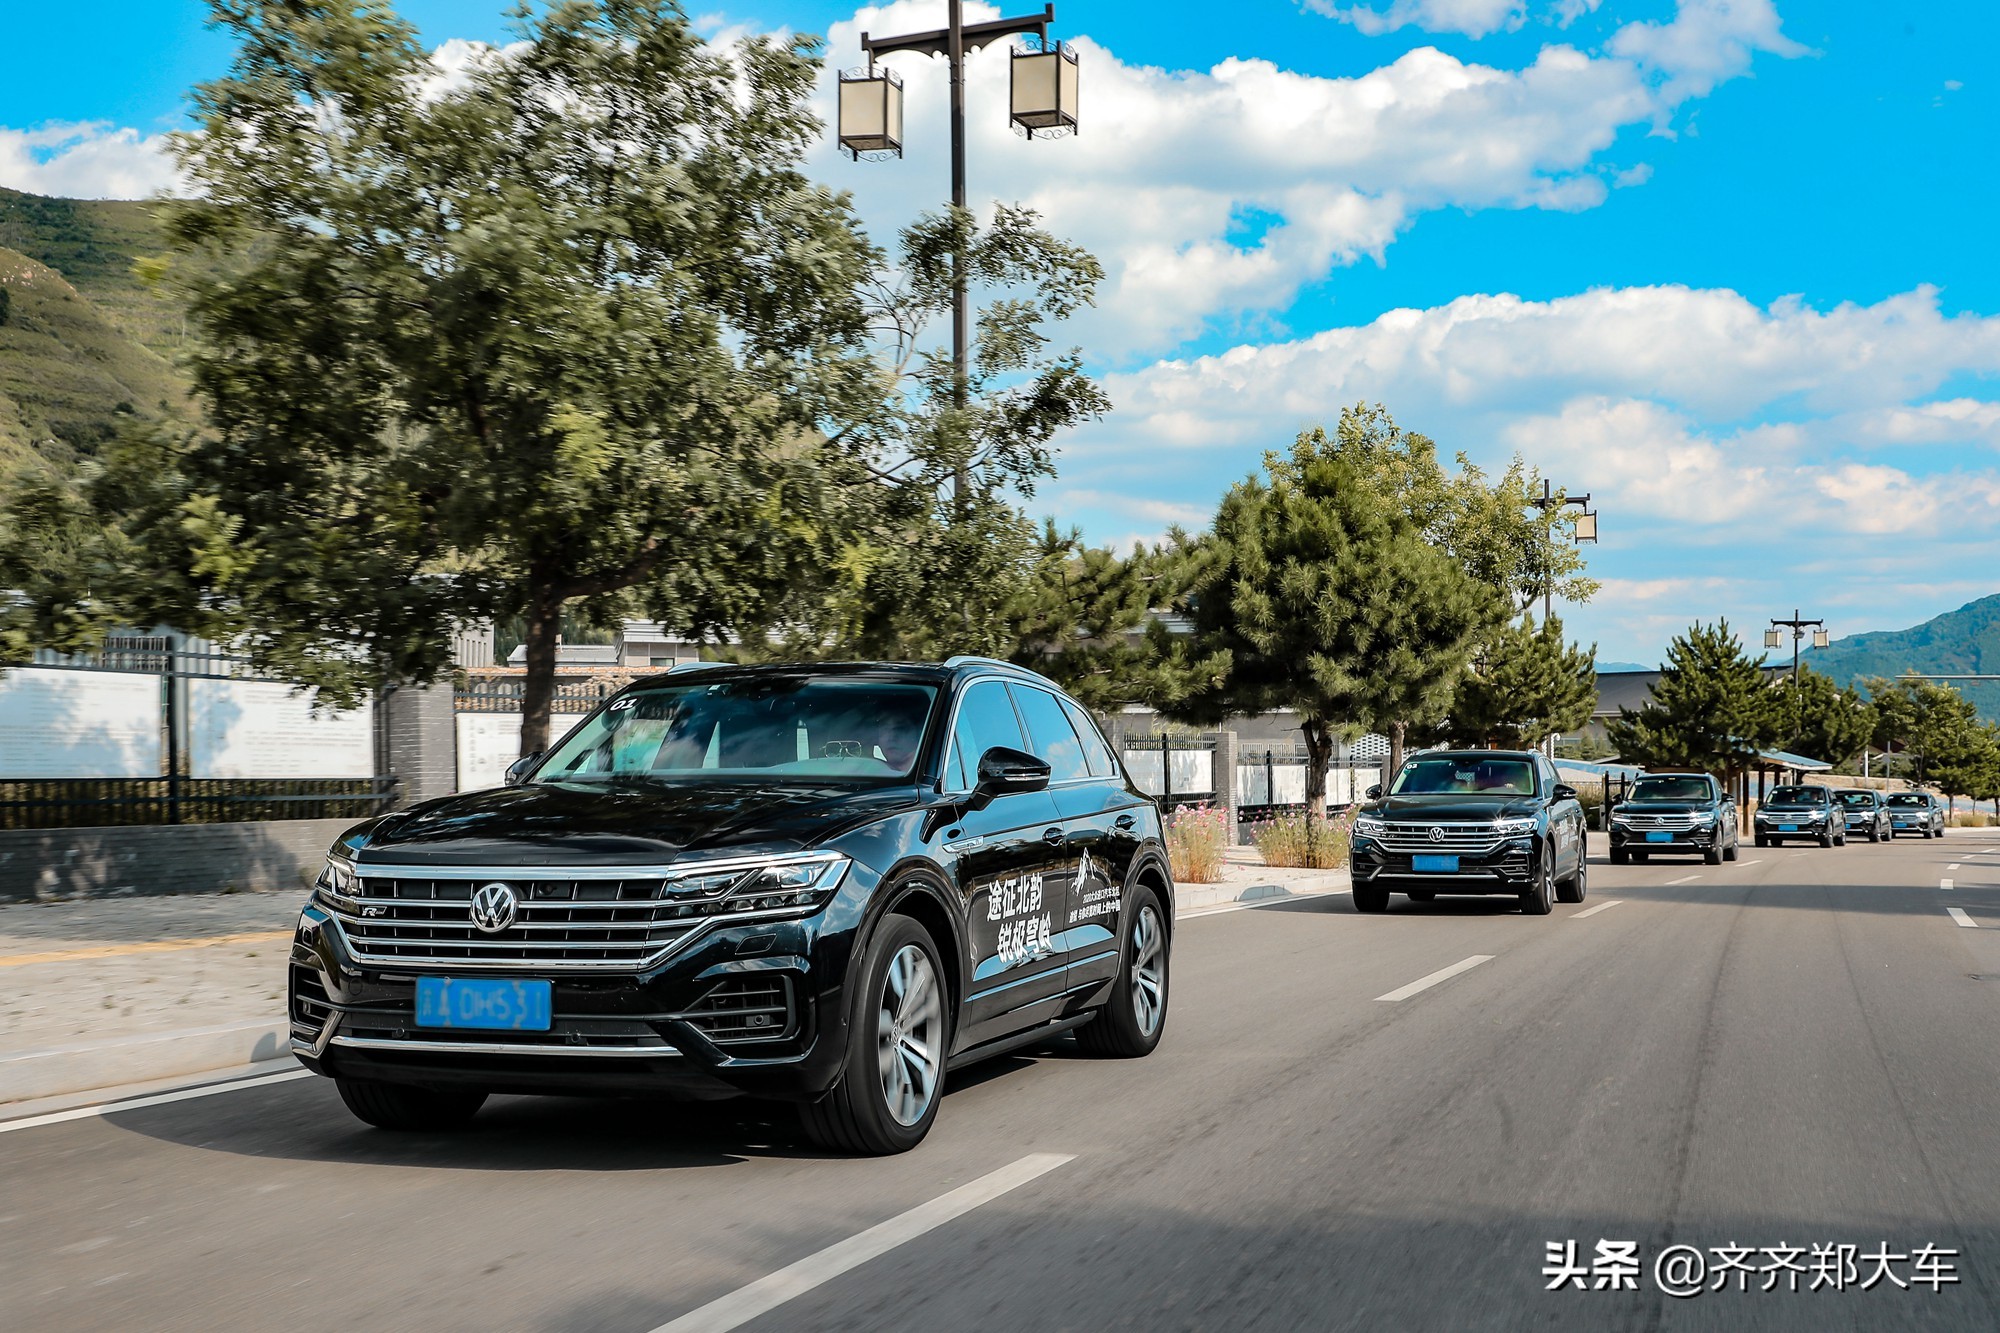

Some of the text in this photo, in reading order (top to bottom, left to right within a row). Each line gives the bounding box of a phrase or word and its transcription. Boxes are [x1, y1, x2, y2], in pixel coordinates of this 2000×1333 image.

[610, 698, 638, 711] 01
[471, 882, 519, 933] VW
[987, 872, 1043, 922] 途征北韵
[997, 910, 1053, 963] 锐极穹岭
